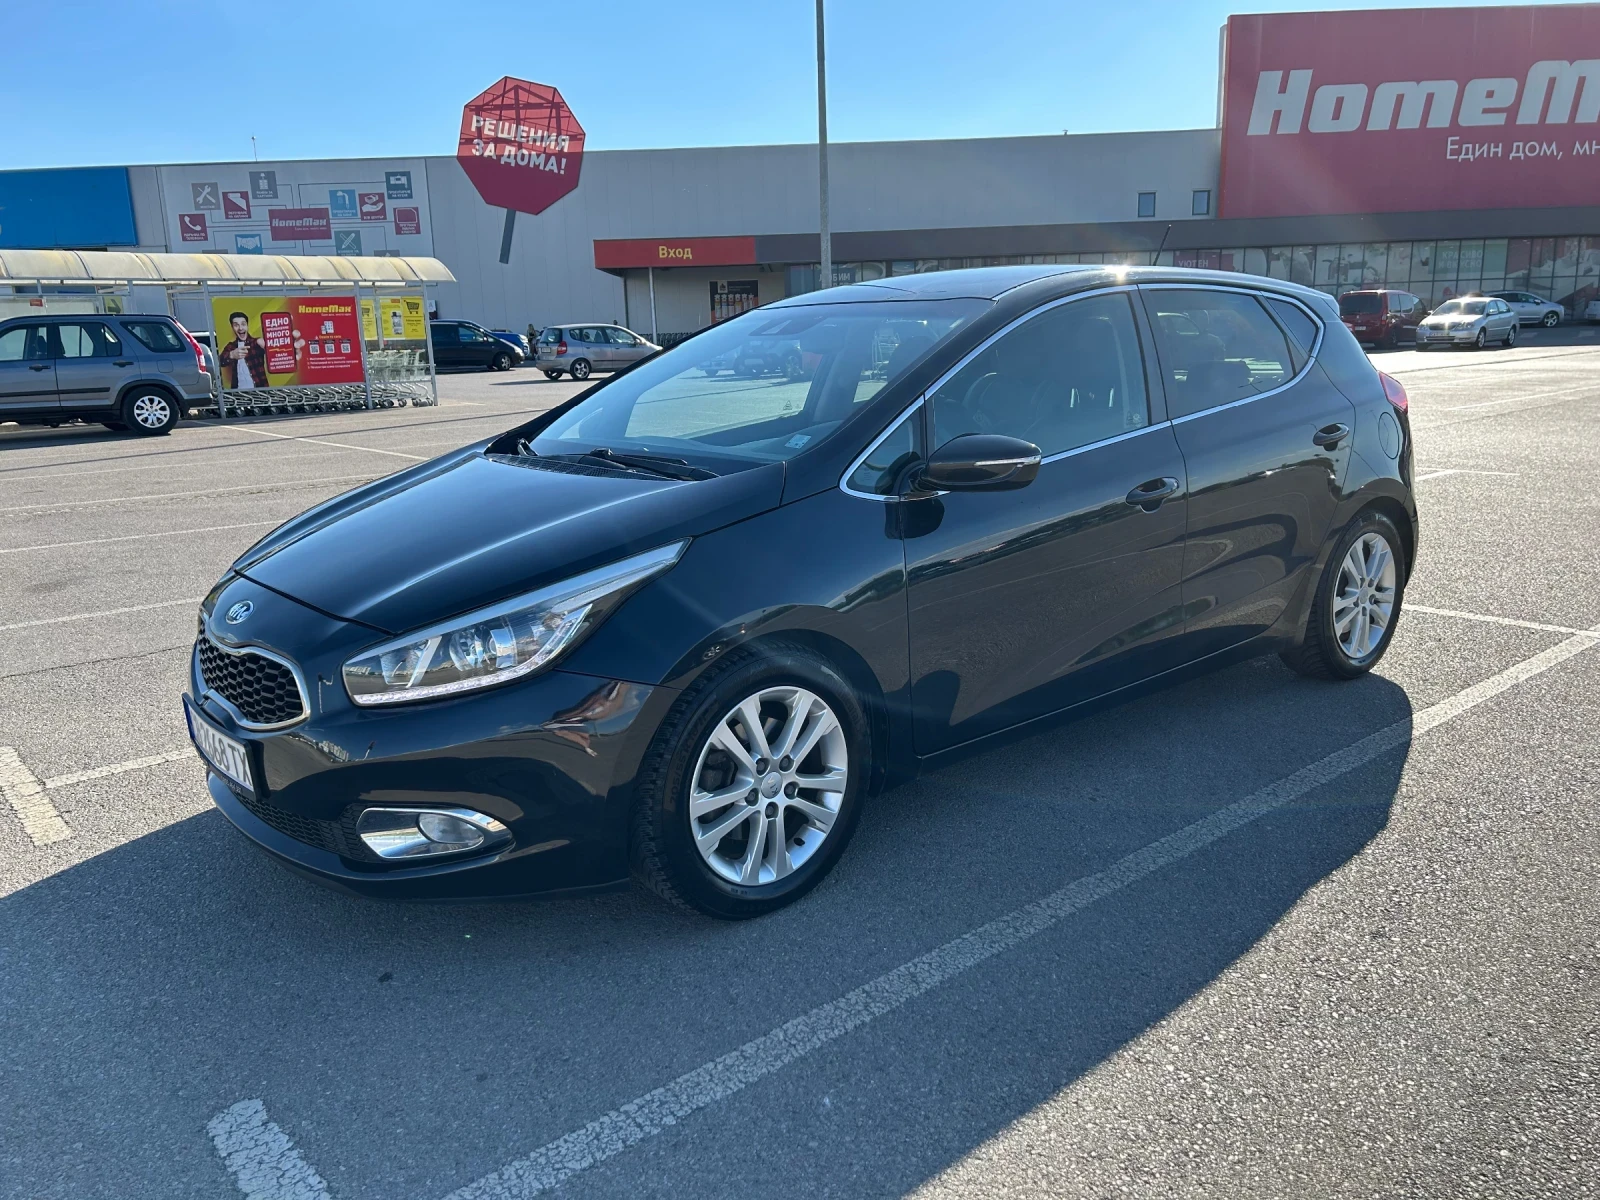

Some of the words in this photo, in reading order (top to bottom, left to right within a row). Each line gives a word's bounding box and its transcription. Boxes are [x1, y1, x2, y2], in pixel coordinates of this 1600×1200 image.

[471, 115, 570, 152] РЕШЕНИЯ
[1447, 137, 1503, 161] Един
[1509, 141, 1563, 161] дом,
[472, 139, 497, 159] ЗА
[501, 145, 567, 174] ДОМА!
[272, 218, 327, 227] HomeMax
[658, 246, 692, 259] Вход
[1442, 250, 1483, 259] КРАСИВО
[298, 305, 352, 313] HomeMax
[265, 317, 289, 327] ЕДНО
[266, 330, 290, 339] МНОГО
[267, 337, 291, 347] ИДЕИ
